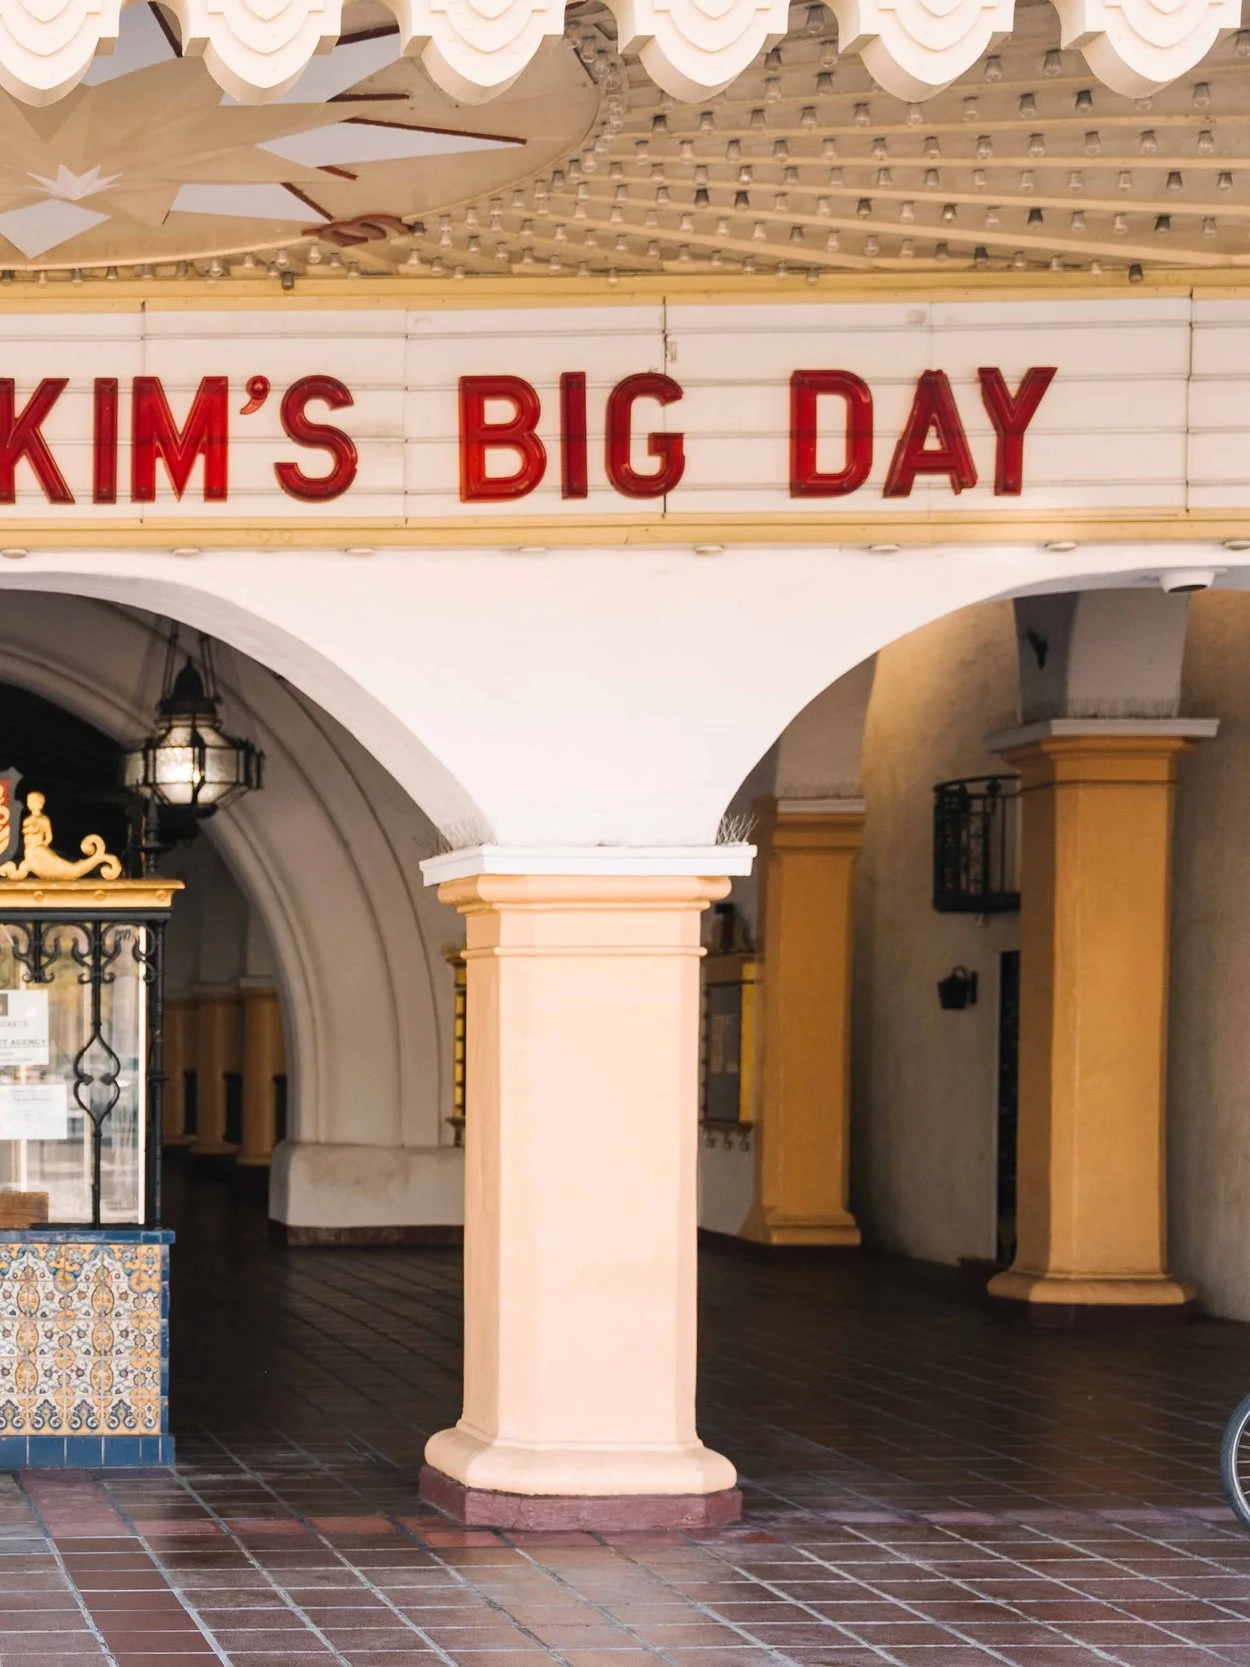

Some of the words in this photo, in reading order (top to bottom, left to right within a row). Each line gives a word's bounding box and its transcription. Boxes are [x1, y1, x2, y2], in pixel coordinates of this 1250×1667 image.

[456, 370, 688, 505] BIG
[787, 366, 1059, 500] DAY
[10, 1038, 47, 1046] AGENCY
